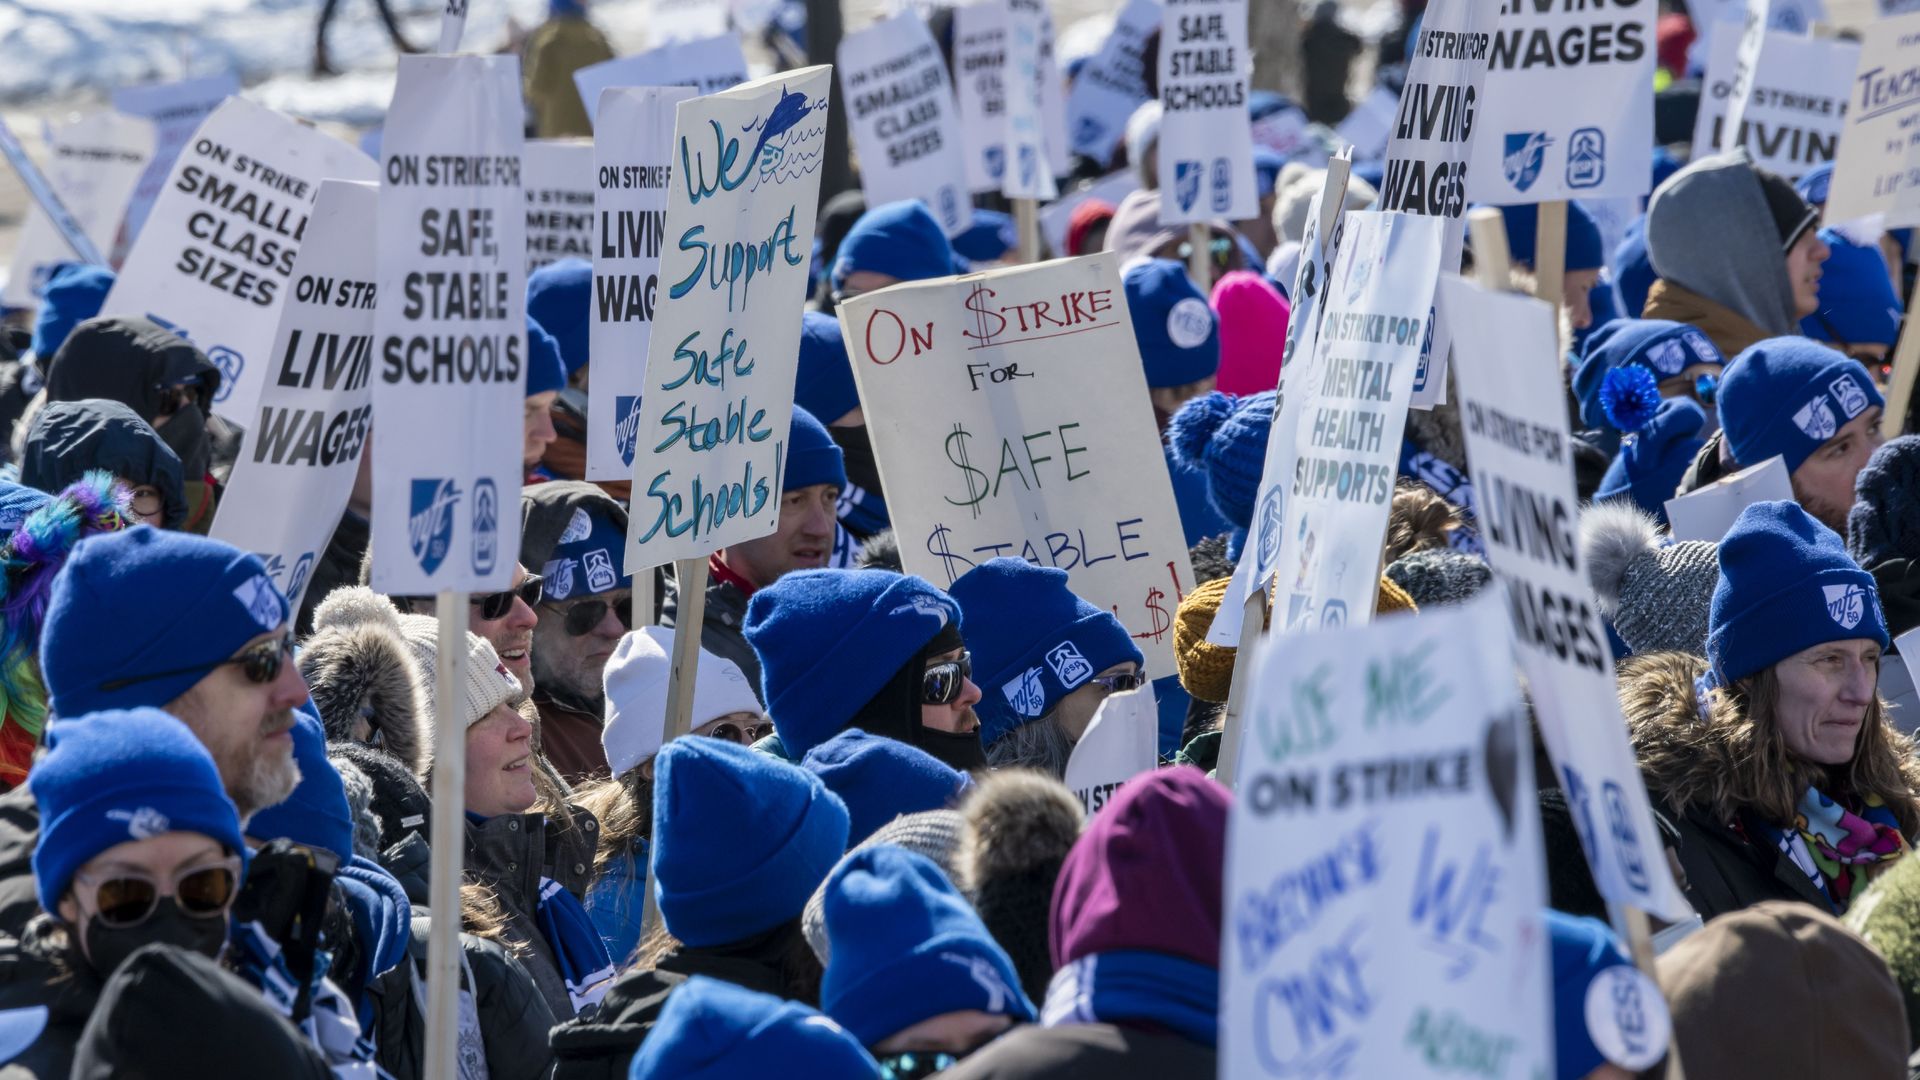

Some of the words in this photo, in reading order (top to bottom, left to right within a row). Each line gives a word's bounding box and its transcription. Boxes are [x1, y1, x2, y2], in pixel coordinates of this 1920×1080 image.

[1170, 47, 1236, 77] STABLE
[1164, 82, 1244, 112] SCHOOLS
[1397, 83, 1476, 142] LIVING
[195, 139, 230, 164] ON
[233, 155, 309, 199] STRIKE
[387, 155, 419, 186] ON
[426, 156, 491, 187] STRIKE
[494, 156, 520, 187] FOR
[600, 166, 619, 189] ON
[624, 166, 663, 189] STRIKE
[681, 119, 757, 205] We
[1382, 160, 1467, 218] WAGES
[188, 212, 296, 277] CLASS
[421, 207, 498, 265] SAFE,
[669, 205, 803, 313] Support
[176, 248, 278, 307] SIZES
[296, 275, 333, 305] ON
[404, 271, 508, 320] STABLE
[1323, 311, 1338, 341] ON
[1340, 313, 1386, 344] STRIKE
[1386, 316, 1421, 347] FOR
[382, 336, 520, 384] SCHOOLS
[661, 328, 754, 391] Safe
[1320, 358, 1394, 401] MENTAL
[253, 403, 372, 467] WAGES
[654, 396, 772, 453] Stable
[1310, 408, 1386, 453] HEALTH
[639, 440, 783, 544] Schools!
[1292, 456, 1390, 506] SUPPORTS
[1827, 584, 1866, 625] mft
[1064, 660, 1081, 675] esp
[1248, 773, 1317, 817] ON
[1329, 750, 1471, 807] STRIKE
